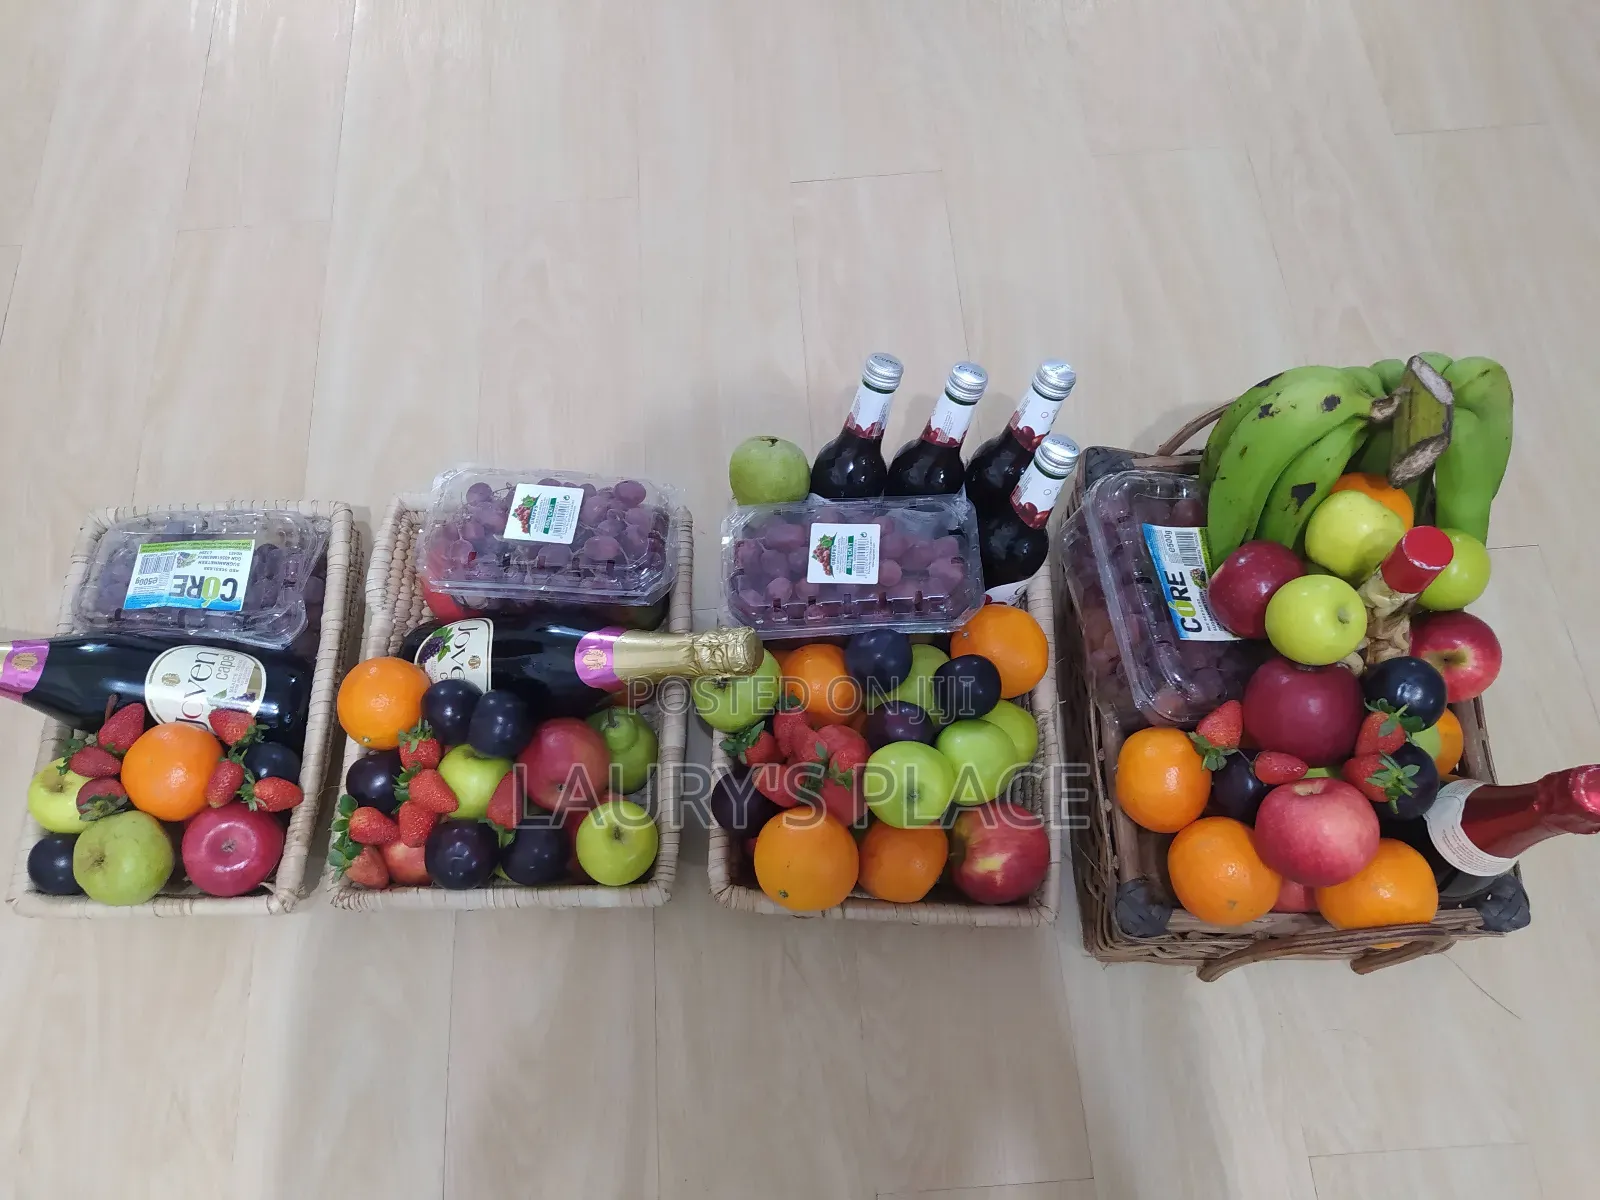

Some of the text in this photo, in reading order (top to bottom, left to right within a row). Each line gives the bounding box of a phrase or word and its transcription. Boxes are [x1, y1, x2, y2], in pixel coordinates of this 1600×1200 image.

[168, 574, 239, 606] CORE
[1164, 570, 1203, 633] CORE
[450, 626, 480, 680] Jove
